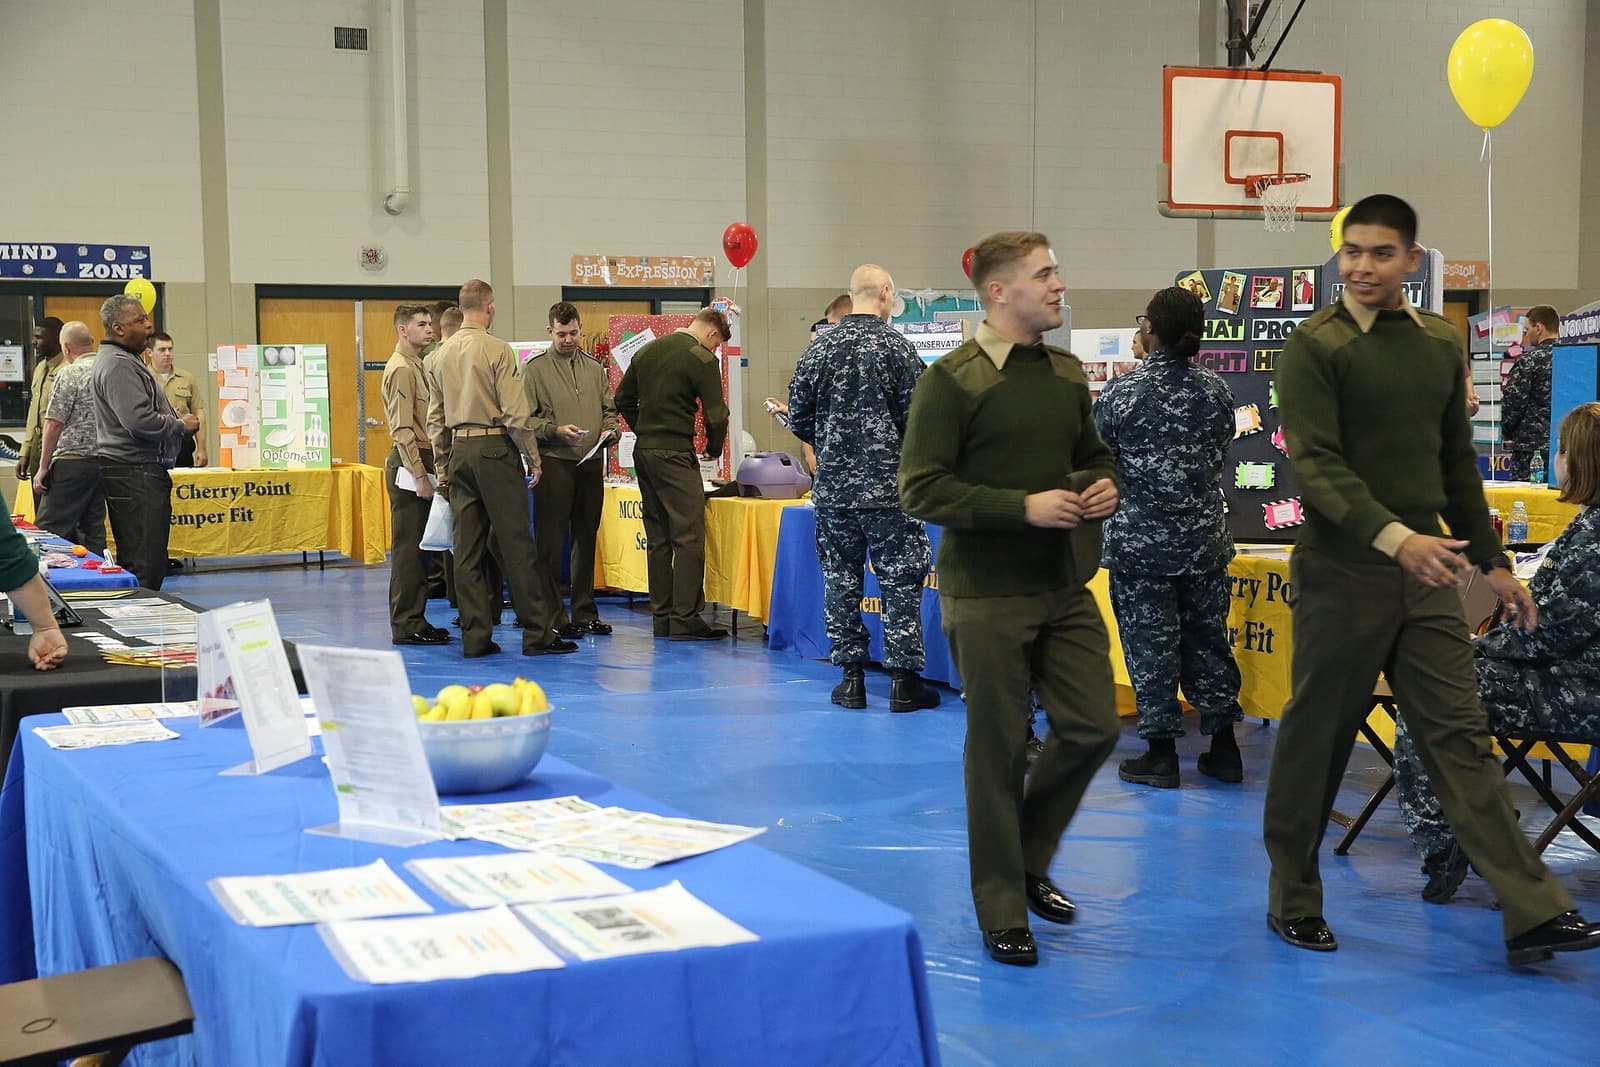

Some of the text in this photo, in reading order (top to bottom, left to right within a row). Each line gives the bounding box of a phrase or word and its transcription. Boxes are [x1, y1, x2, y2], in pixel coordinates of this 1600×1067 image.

[79, 263, 143, 279] ZONE
[616, 263, 698, 280] EXPRESSION
[1443, 263, 1476, 277] ESSION
[1203, 320, 1243, 338] HAT
[912, 340, 962, 349] CONSERVATIO
[1193, 352, 1245, 372] GHT
[262, 449, 321, 463] Optometry
[1488, 456, 1511, 471] MC
[176, 481, 292, 501] Cherry Point
[170, 507, 254, 528] emper Fit
[1229, 576, 1262, 608] rry
[1244, 621, 1275, 654] Fit
